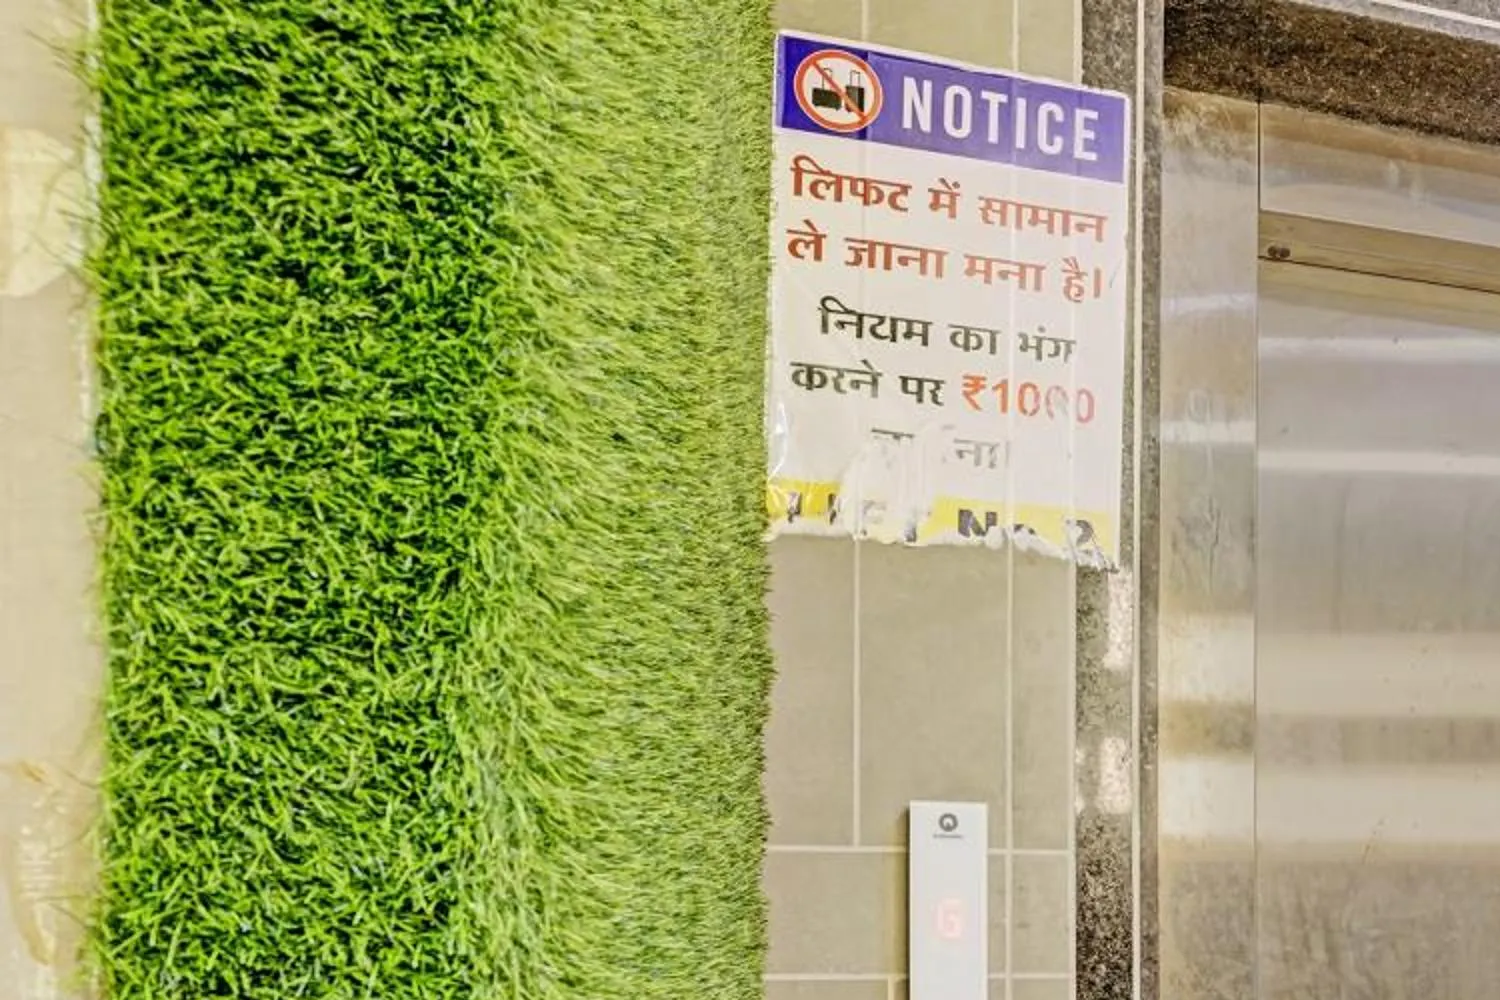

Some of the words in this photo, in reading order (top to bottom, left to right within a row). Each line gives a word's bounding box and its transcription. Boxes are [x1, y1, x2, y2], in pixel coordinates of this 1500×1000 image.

[903, 77, 1099, 161] NOTICE
[790, 154, 912, 212] लिफट
[928, 178, 960, 219] में
[978, 195, 1108, 243] सामान
[786, 220, 827, 261] ले
[844, 237, 949, 278] जाना
[964, 252, 1046, 292] मना
[818, 296, 932, 347] नियम
[949, 324, 1002, 355] का
[790, 359, 882, 398] करने
[899, 375, 945, 406] पर
